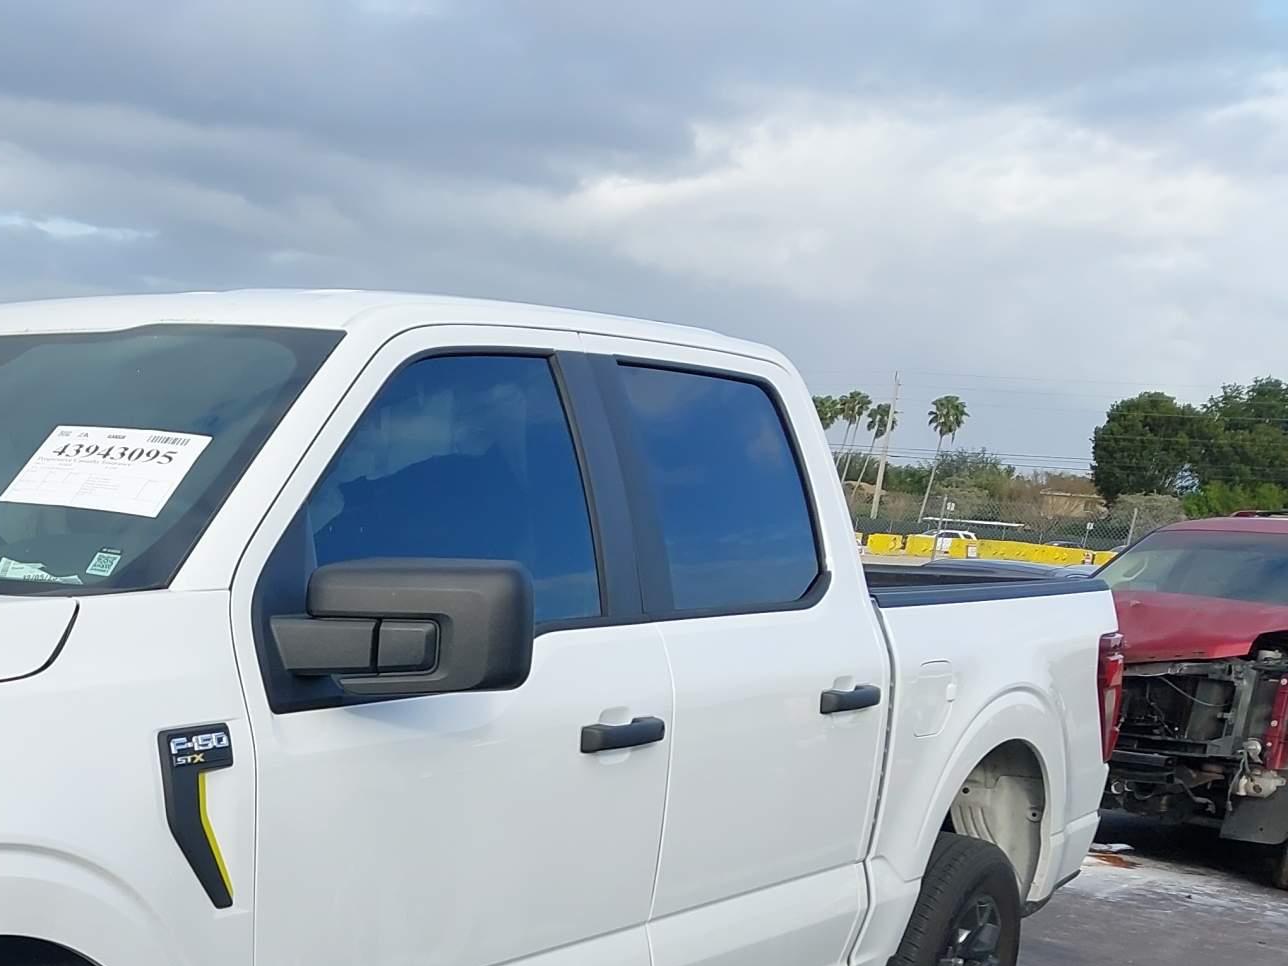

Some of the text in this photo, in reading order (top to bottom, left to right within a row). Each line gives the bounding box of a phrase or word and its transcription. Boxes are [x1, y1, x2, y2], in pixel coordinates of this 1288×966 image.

[52, 443, 178, 465] 43943095
[170, 732, 229, 754] F-150
[176, 753, 205, 765] STX
